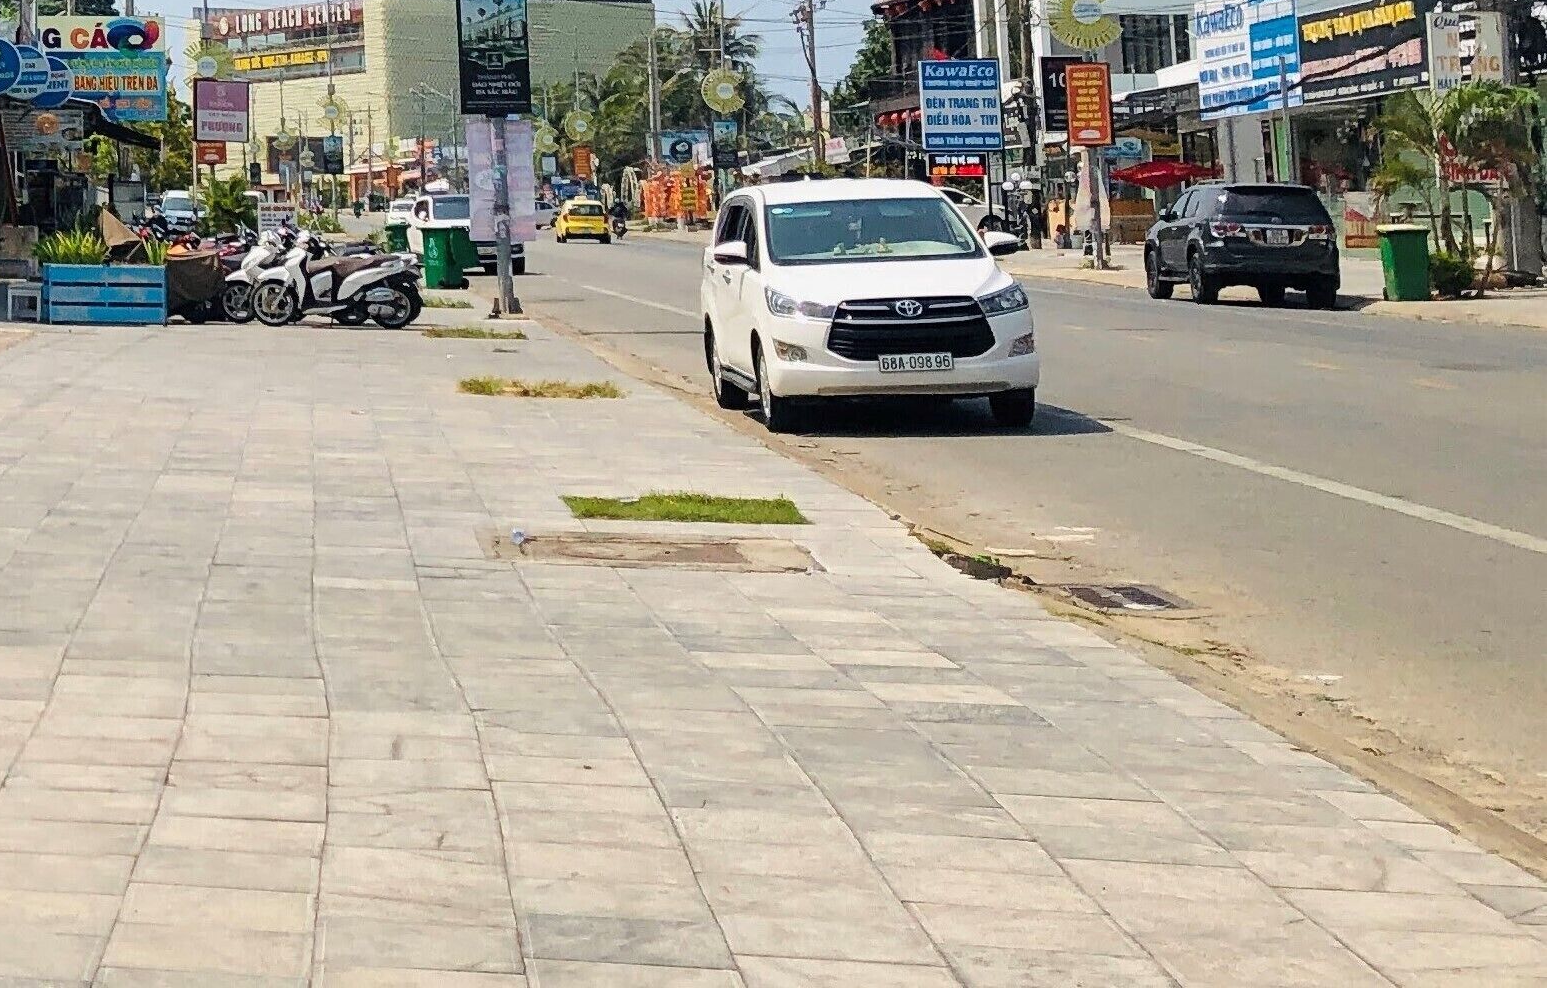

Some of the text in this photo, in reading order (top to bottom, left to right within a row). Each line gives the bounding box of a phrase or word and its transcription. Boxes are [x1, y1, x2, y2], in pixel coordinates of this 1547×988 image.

[235, 12, 262, 34] LONG
[268, 7, 302, 30] BEACH
[948, 97, 979, 109] TRANG
